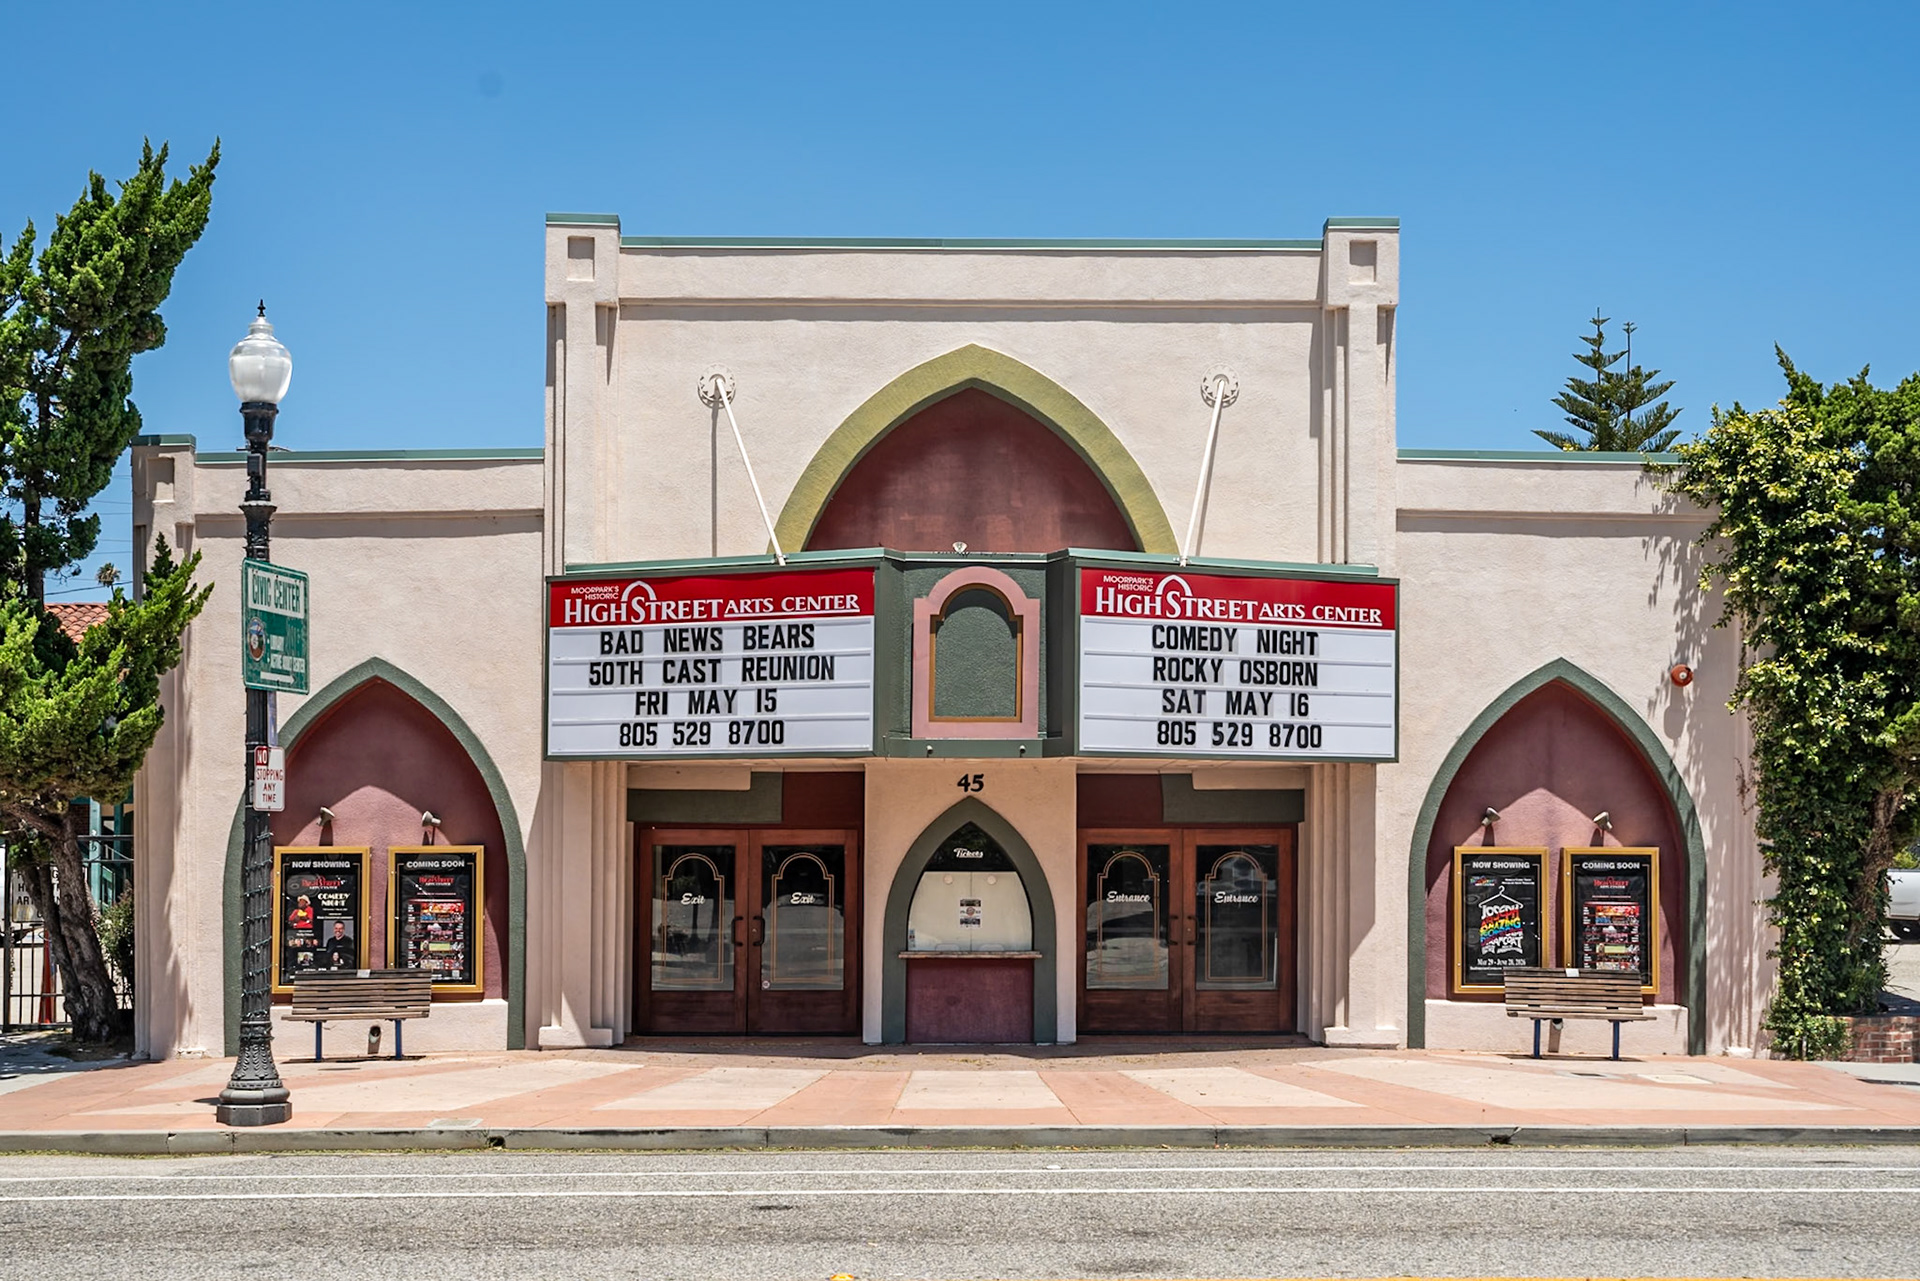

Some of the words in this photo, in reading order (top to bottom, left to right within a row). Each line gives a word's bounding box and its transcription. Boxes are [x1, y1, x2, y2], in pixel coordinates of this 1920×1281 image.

[1103, 575, 1153, 585] MOORPARK'S
[252, 573, 271, 608] CIVIC
[274, 577, 301, 614] CENTER
[571, 586, 619, 595] MOORPARK'S
[1118, 584, 1153, 592] HISTORIC
[564, 599, 627, 623] HIGH
[630, 596, 723, 623] STREET
[724, 598, 774, 615] ARTS
[781, 594, 860, 612] CENTER
[1096, 586, 1162, 616] HIGH
[1166, 591, 1258, 620] STREET
[1258, 603, 1305, 619] ARTS
[1312, 605, 1382, 623] CENTER
[601, 630, 643, 655] BAD
[664, 627, 723, 653] NEWS
[743, 624, 815, 650] BEARS
[1152, 624, 1238, 653] COMEDY
[1257, 629, 1319, 656] NIGHT
[589, 661, 643, 686] 50TH
[662, 658, 722, 684] CAST
[742, 655, 835, 682] REUNION
[1153, 656, 1223, 683] ROCKY
[1240, 660, 1318, 687] OSBORN
[635, 691, 668, 715] FRI
[688, 689, 738, 715] MAY
[756, 688, 777, 713] 15
[1162, 688, 1206, 714] SAT
[1225, 690, 1273, 716] MAY
[1290, 692, 1309, 717] 16
[619, 722, 658, 747] 805
[673, 721, 711, 746] 529
[728, 720, 784, 745] 8700
[1157, 720, 1197, 746] 805
[1211, 722, 1253, 747] 529
[1269, 723, 1322, 749] 8700
[256, 749, 268, 765] NO
[256, 768, 284, 781] STOPPING
[263, 782, 276, 792] ANY
[957, 773, 985, 792] 45
[262, 793, 276, 803] TIME
[953, 847, 984, 858] Tickets
[441, 860, 465, 868] SOON
[1472, 861, 1491, 869] NOW
[1492, 861, 1530, 869] SHOWING
[681, 893, 706, 905] Exit
[790, 892, 815, 905] Exit
[1106, 890, 1151, 903] Entrance
[1214, 891, 1259, 904] Entrance
